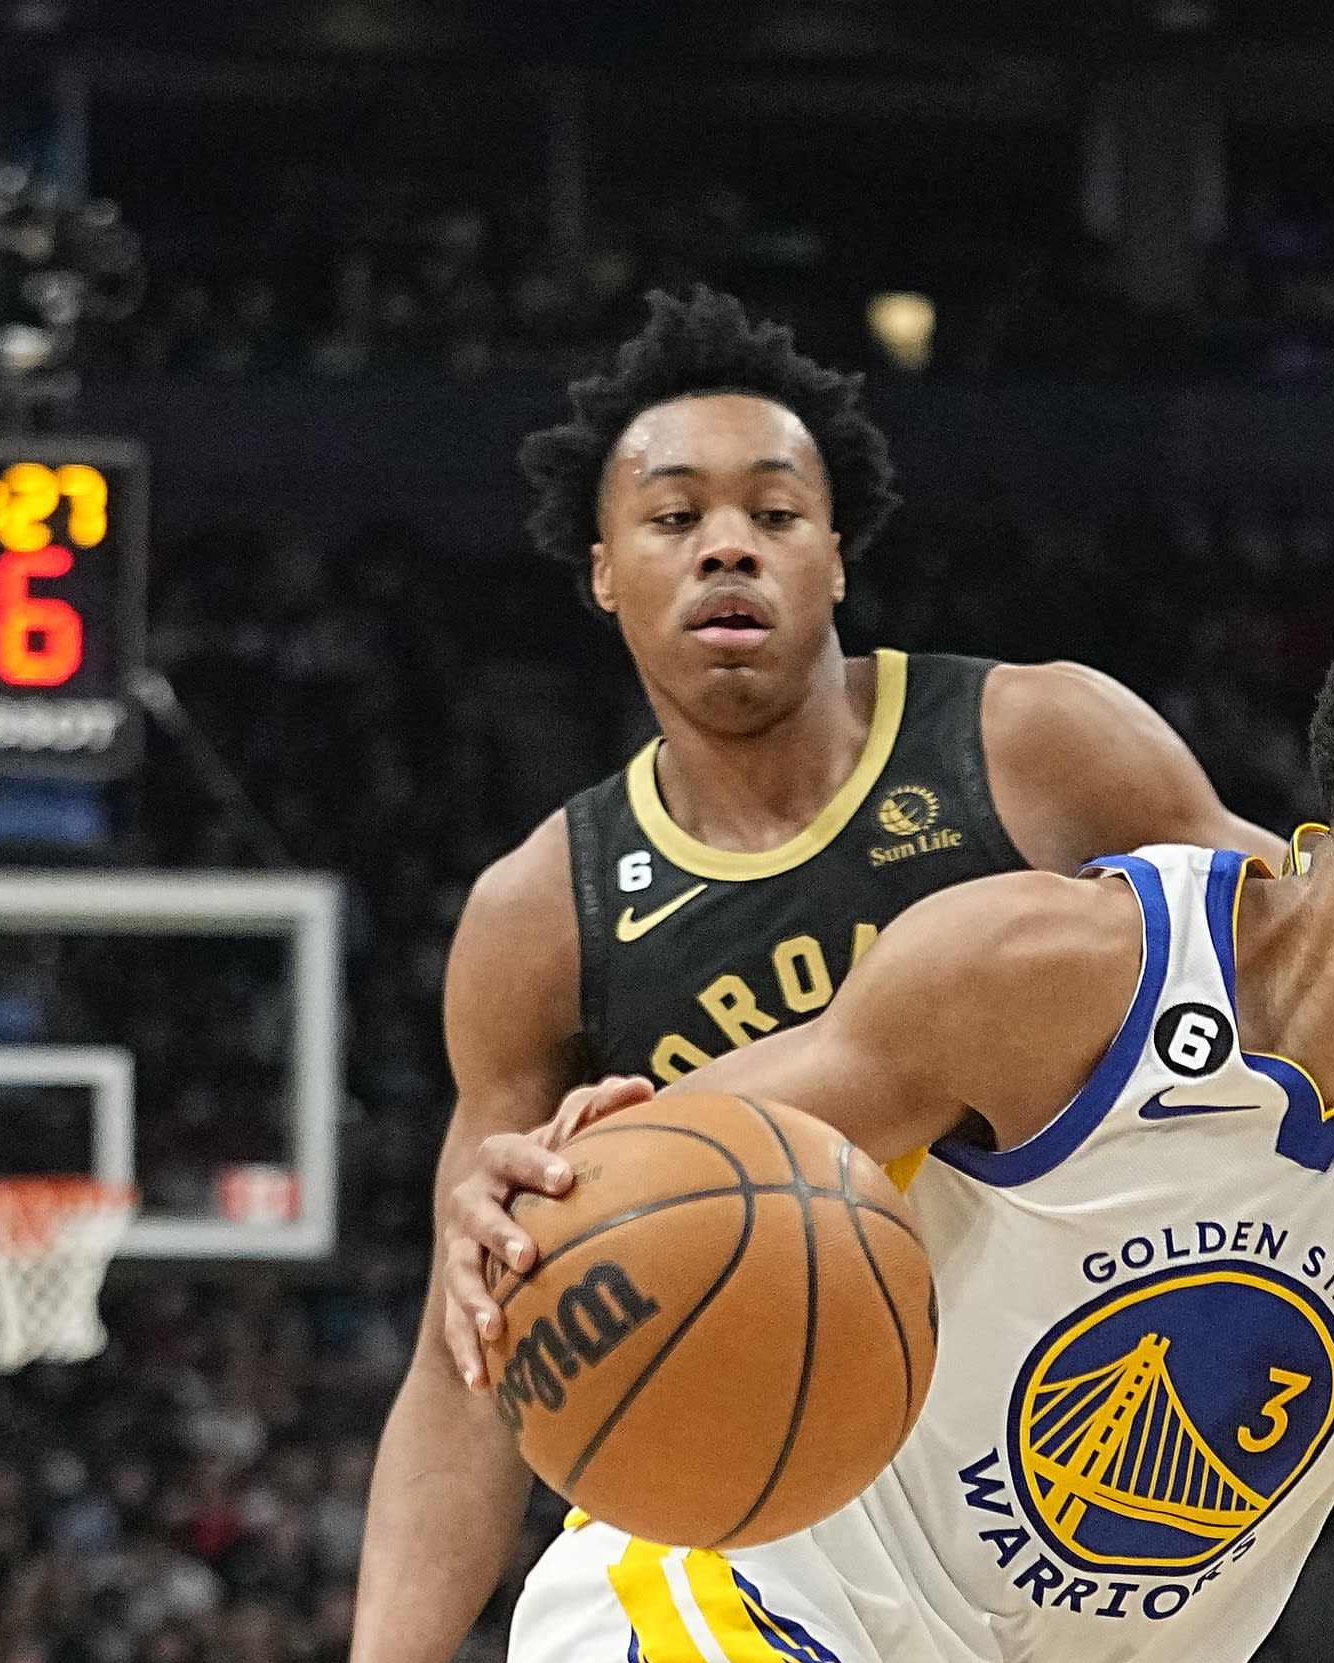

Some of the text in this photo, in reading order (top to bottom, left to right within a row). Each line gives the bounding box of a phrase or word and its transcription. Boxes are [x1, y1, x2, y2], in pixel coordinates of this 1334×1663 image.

[618, 850, 653, 893] 6
[870, 828, 963, 867] Sun Life
[1167, 1012, 1220, 1069] 6
[1082, 1222, 1288, 1285] GOLDEN
[1238, 1367, 1312, 1453] 3
